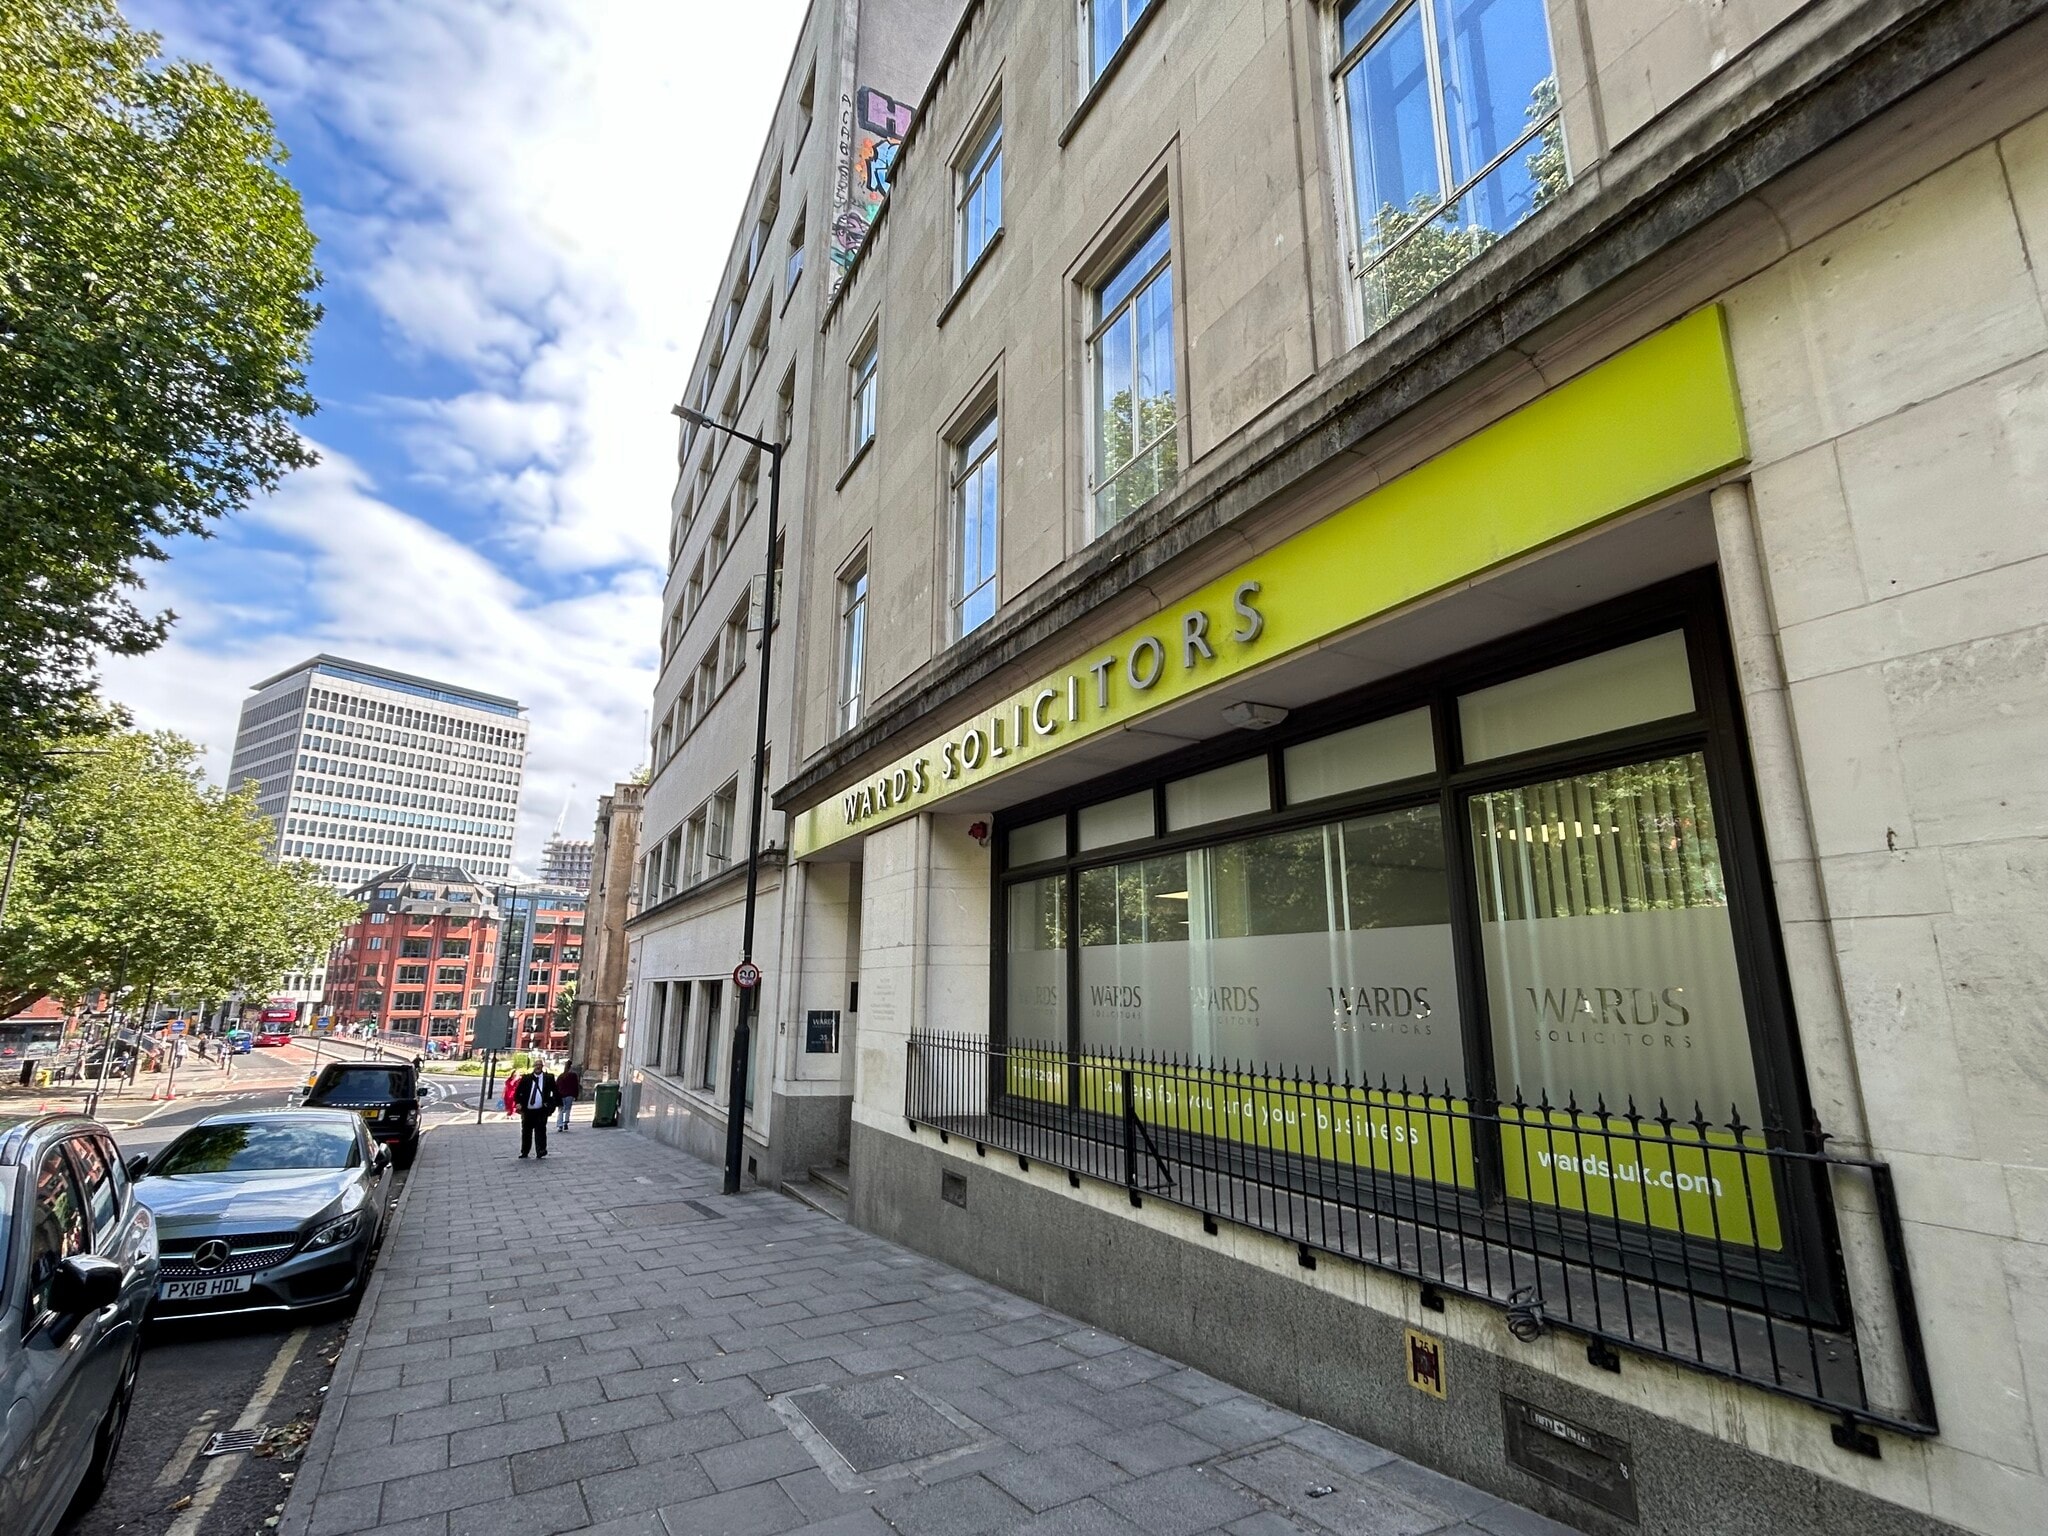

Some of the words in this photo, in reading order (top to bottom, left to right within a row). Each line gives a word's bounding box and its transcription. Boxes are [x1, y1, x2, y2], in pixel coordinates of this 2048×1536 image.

[842, 757, 929, 824] WARDS
[942, 580, 1264, 780] SOLICITORS
[1090, 985, 1142, 1008] WARDS
[1326, 987, 1431, 1019] WARDS
[1526, 986, 1690, 1027] WARDS
[1535, 1029, 1692, 1048] SOLICITORS
[1316, 1108, 1419, 1145] business
[1537, 1150, 1723, 1197] wards.uk.com
[168, 1282, 207, 1298] PX18
[211, 1278, 244, 1294] HDL
